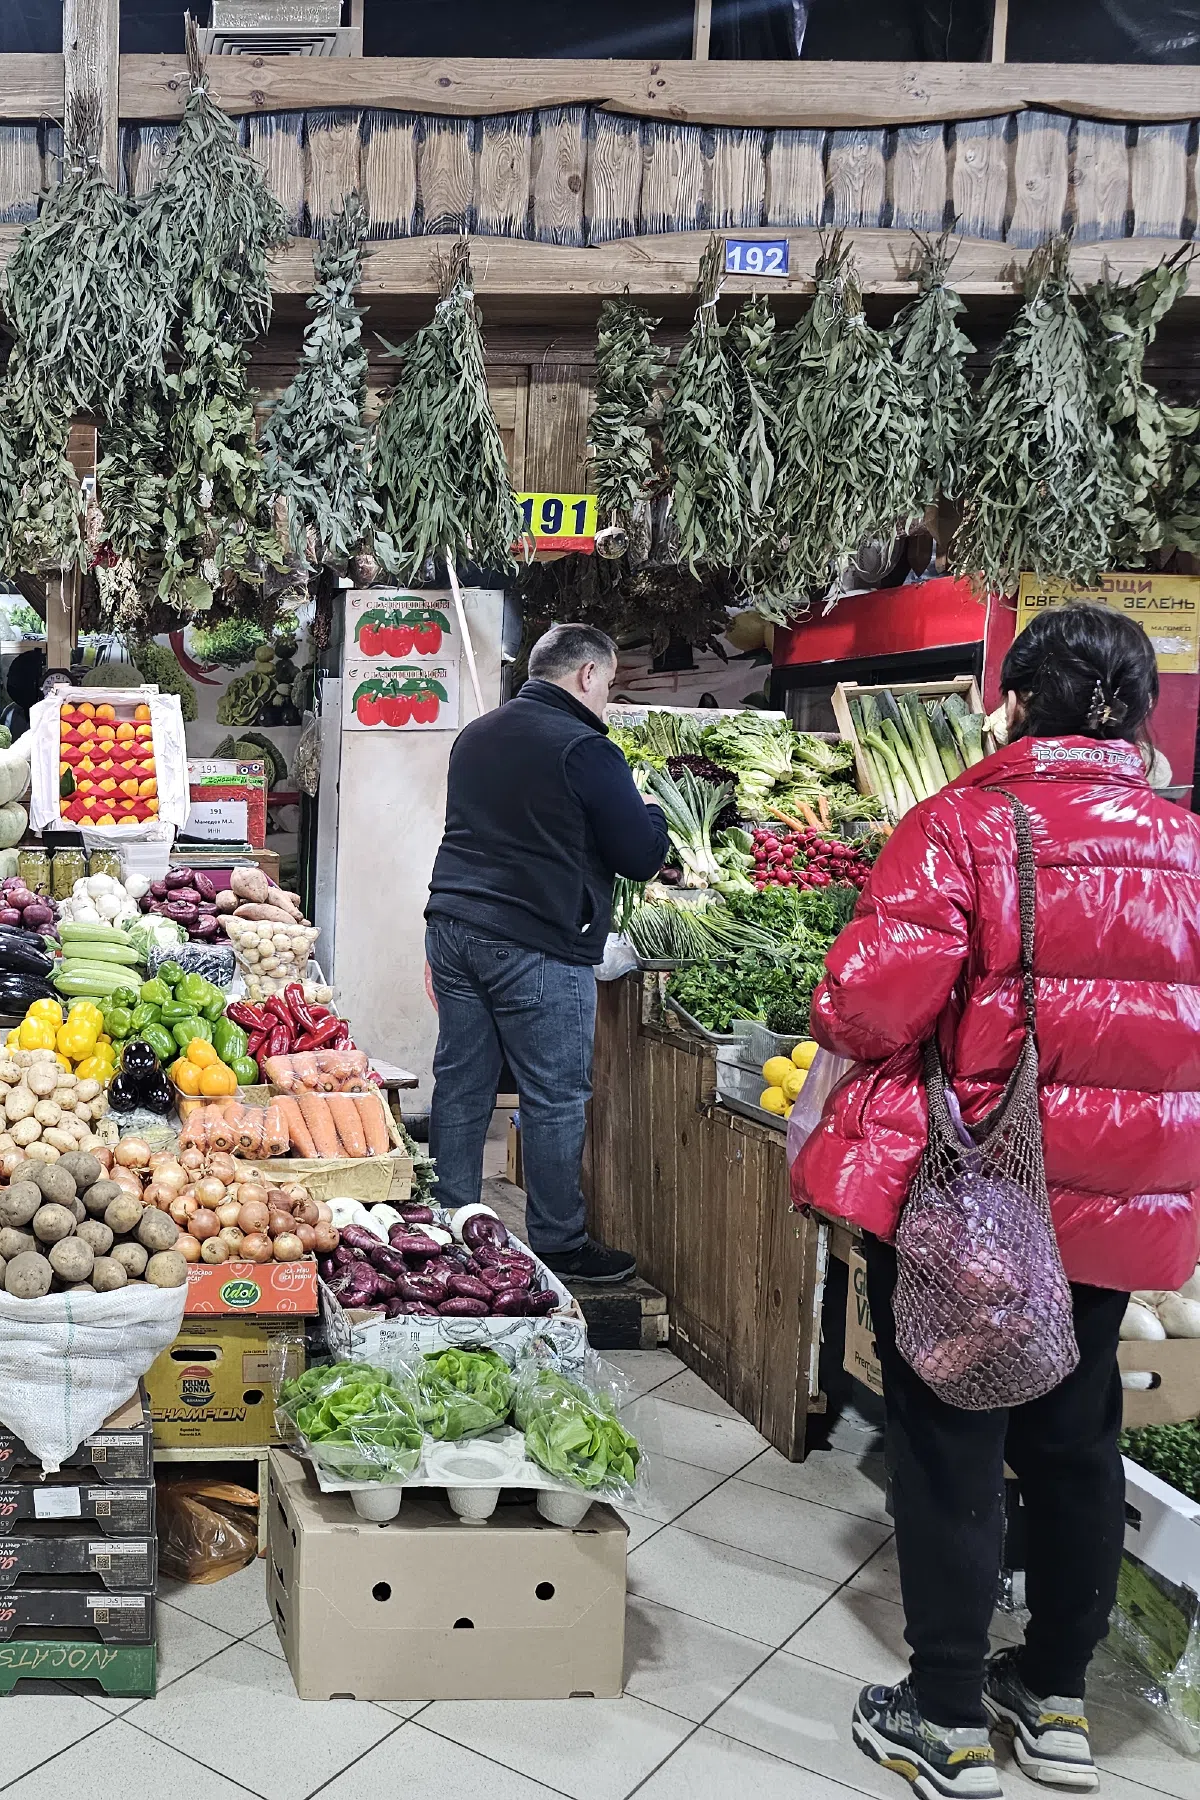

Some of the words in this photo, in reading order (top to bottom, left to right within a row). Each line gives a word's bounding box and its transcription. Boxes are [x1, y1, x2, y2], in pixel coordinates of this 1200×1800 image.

[728, 246, 783, 273] 192
[520, 498, 587, 534] 191
[1124, 597, 1195, 610] ЗЕЛЕНЬ
[1037, 748, 1104, 761] BOSCO
[225, 1283, 257, 1299] idol
[150, 1407, 246, 1422] CHAMPION
[1055, 1716, 1079, 1726] ASH
[965, 1751, 988, 1760] ASH
